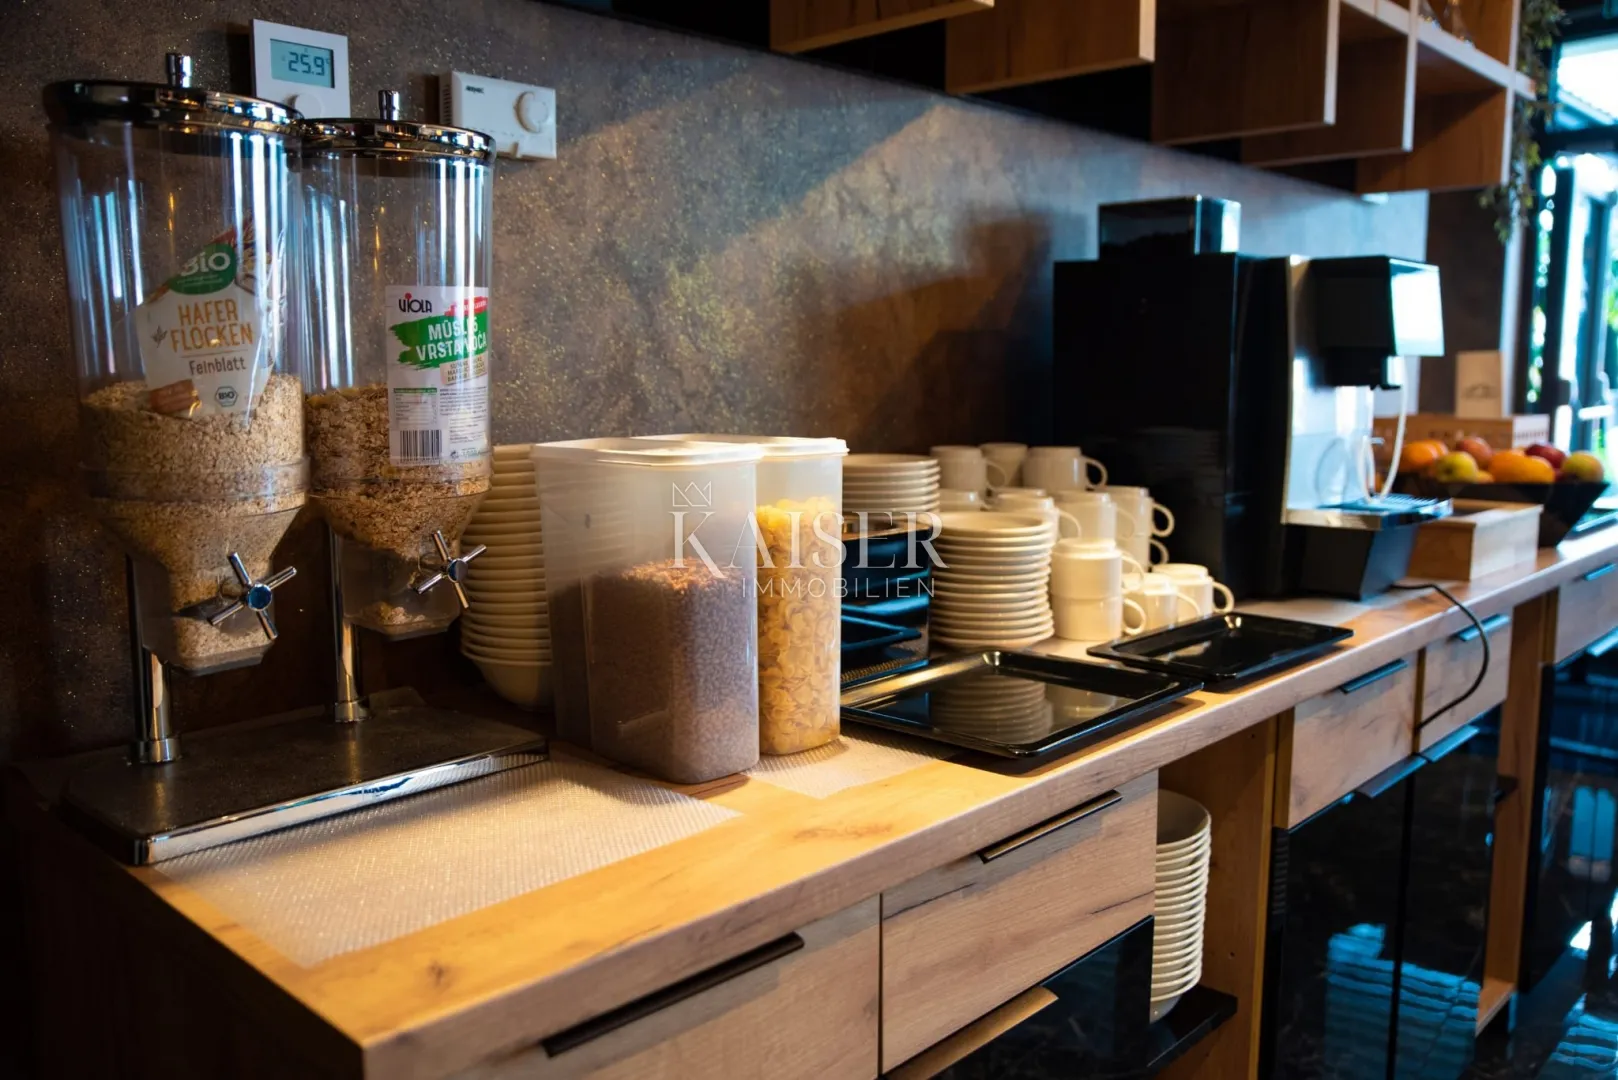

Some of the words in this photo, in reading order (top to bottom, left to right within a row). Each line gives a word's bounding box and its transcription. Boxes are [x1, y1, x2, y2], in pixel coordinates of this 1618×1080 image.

[288, 51, 325, 76] 25.9
[178, 298, 239, 327] HAFER
[169, 323, 254, 353] FLOCKEN
[427, 317, 472, 341] MÜSL
[188, 356, 247, 376] Feinblatt
